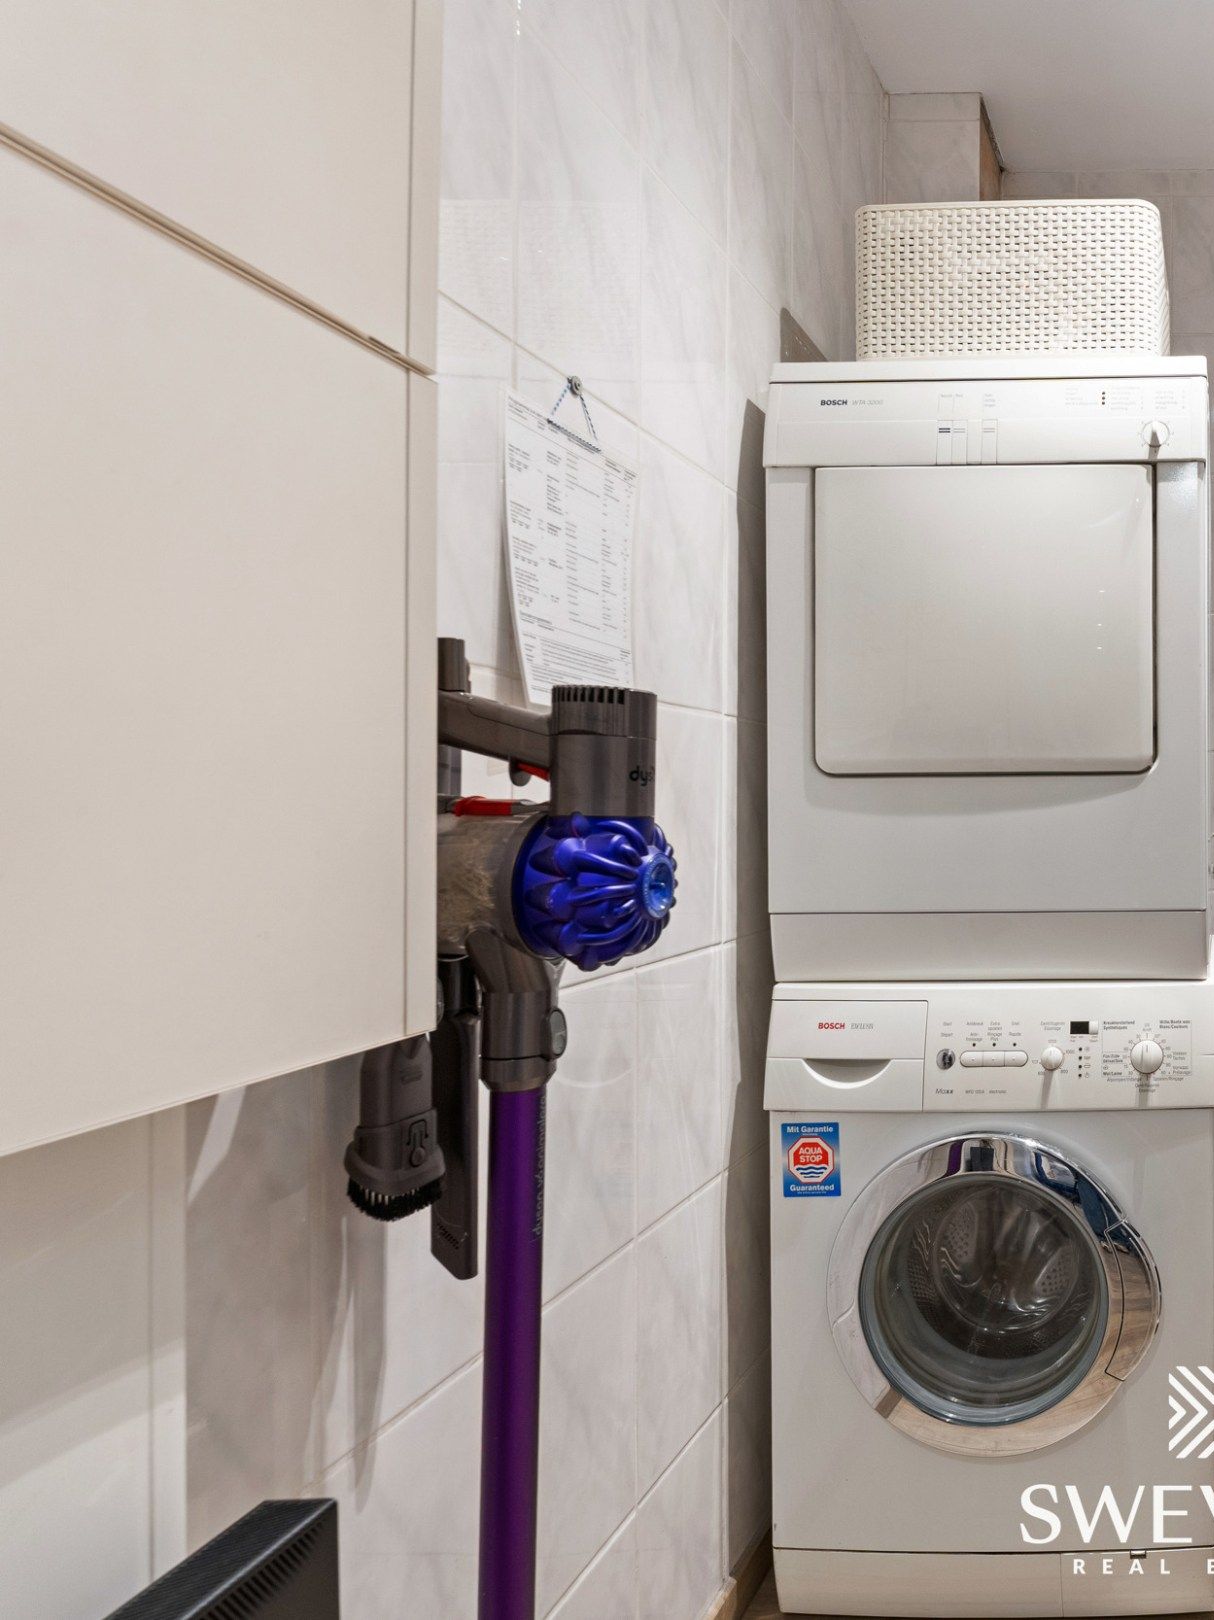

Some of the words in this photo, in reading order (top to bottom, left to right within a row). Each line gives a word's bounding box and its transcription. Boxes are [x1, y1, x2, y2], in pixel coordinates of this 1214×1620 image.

[818, 1022, 846, 1030] BOSCH
[801, 1125, 834, 1133] Garantie
[799, 1147, 823, 1155] AQUA
[799, 1155, 823, 1163] STOP
[789, 1184, 835, 1192] Guaranteed
